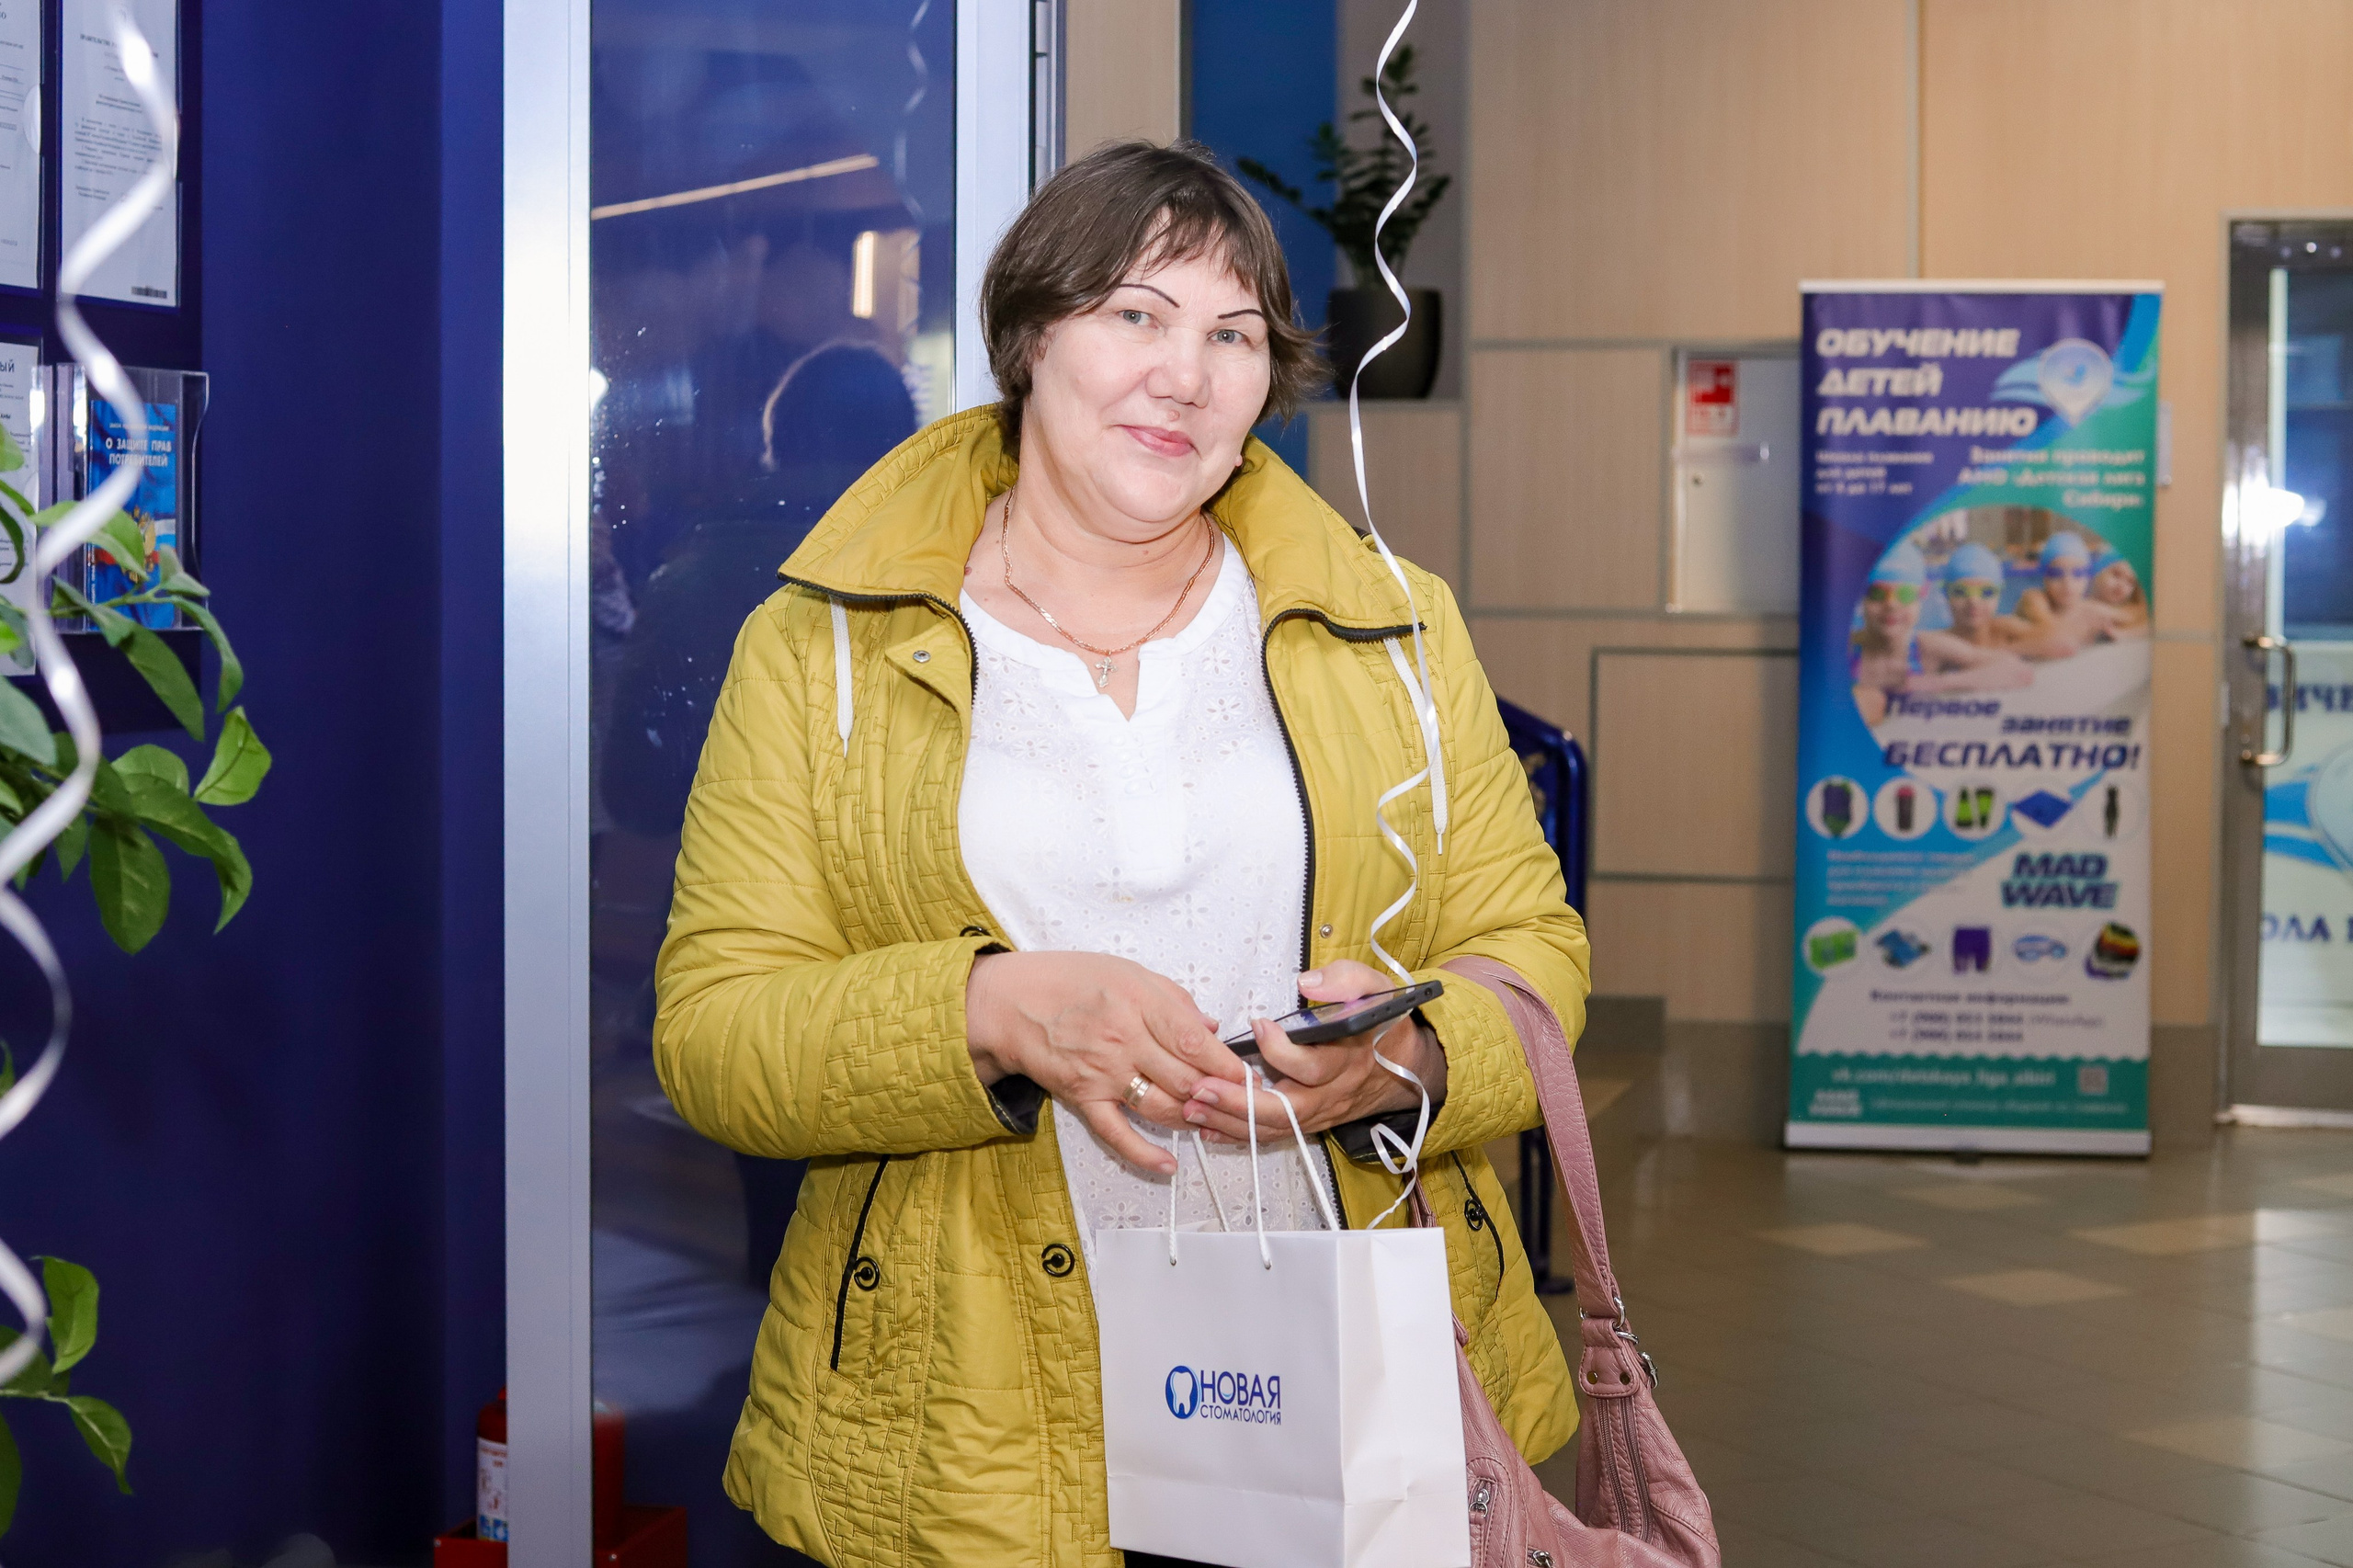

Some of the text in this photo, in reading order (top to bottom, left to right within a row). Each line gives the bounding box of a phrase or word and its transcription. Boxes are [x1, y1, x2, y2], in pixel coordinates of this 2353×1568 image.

[1816, 328, 2020, 358] ОБУЧЕНИЕ
[1817, 363, 1944, 397] ДЕТЕЙ
[1816, 407, 2038, 437] ПЛАВАНИЮ
[105, 437, 172, 453] О ЗАЩИТЕ ПРАВ
[1884, 693, 2000, 721] Первое
[2001, 716, 2131, 734] занятие
[1884, 741, 2140, 769] БЕСПЛАТНО!
[2014, 853, 2109, 880] MAD
[2001, 881, 2118, 908] WAVE
[1200, 1369, 1281, 1409] НОВАЯ
[1199, 1403, 1282, 1426] СТОМАТОЛОГИЯ
